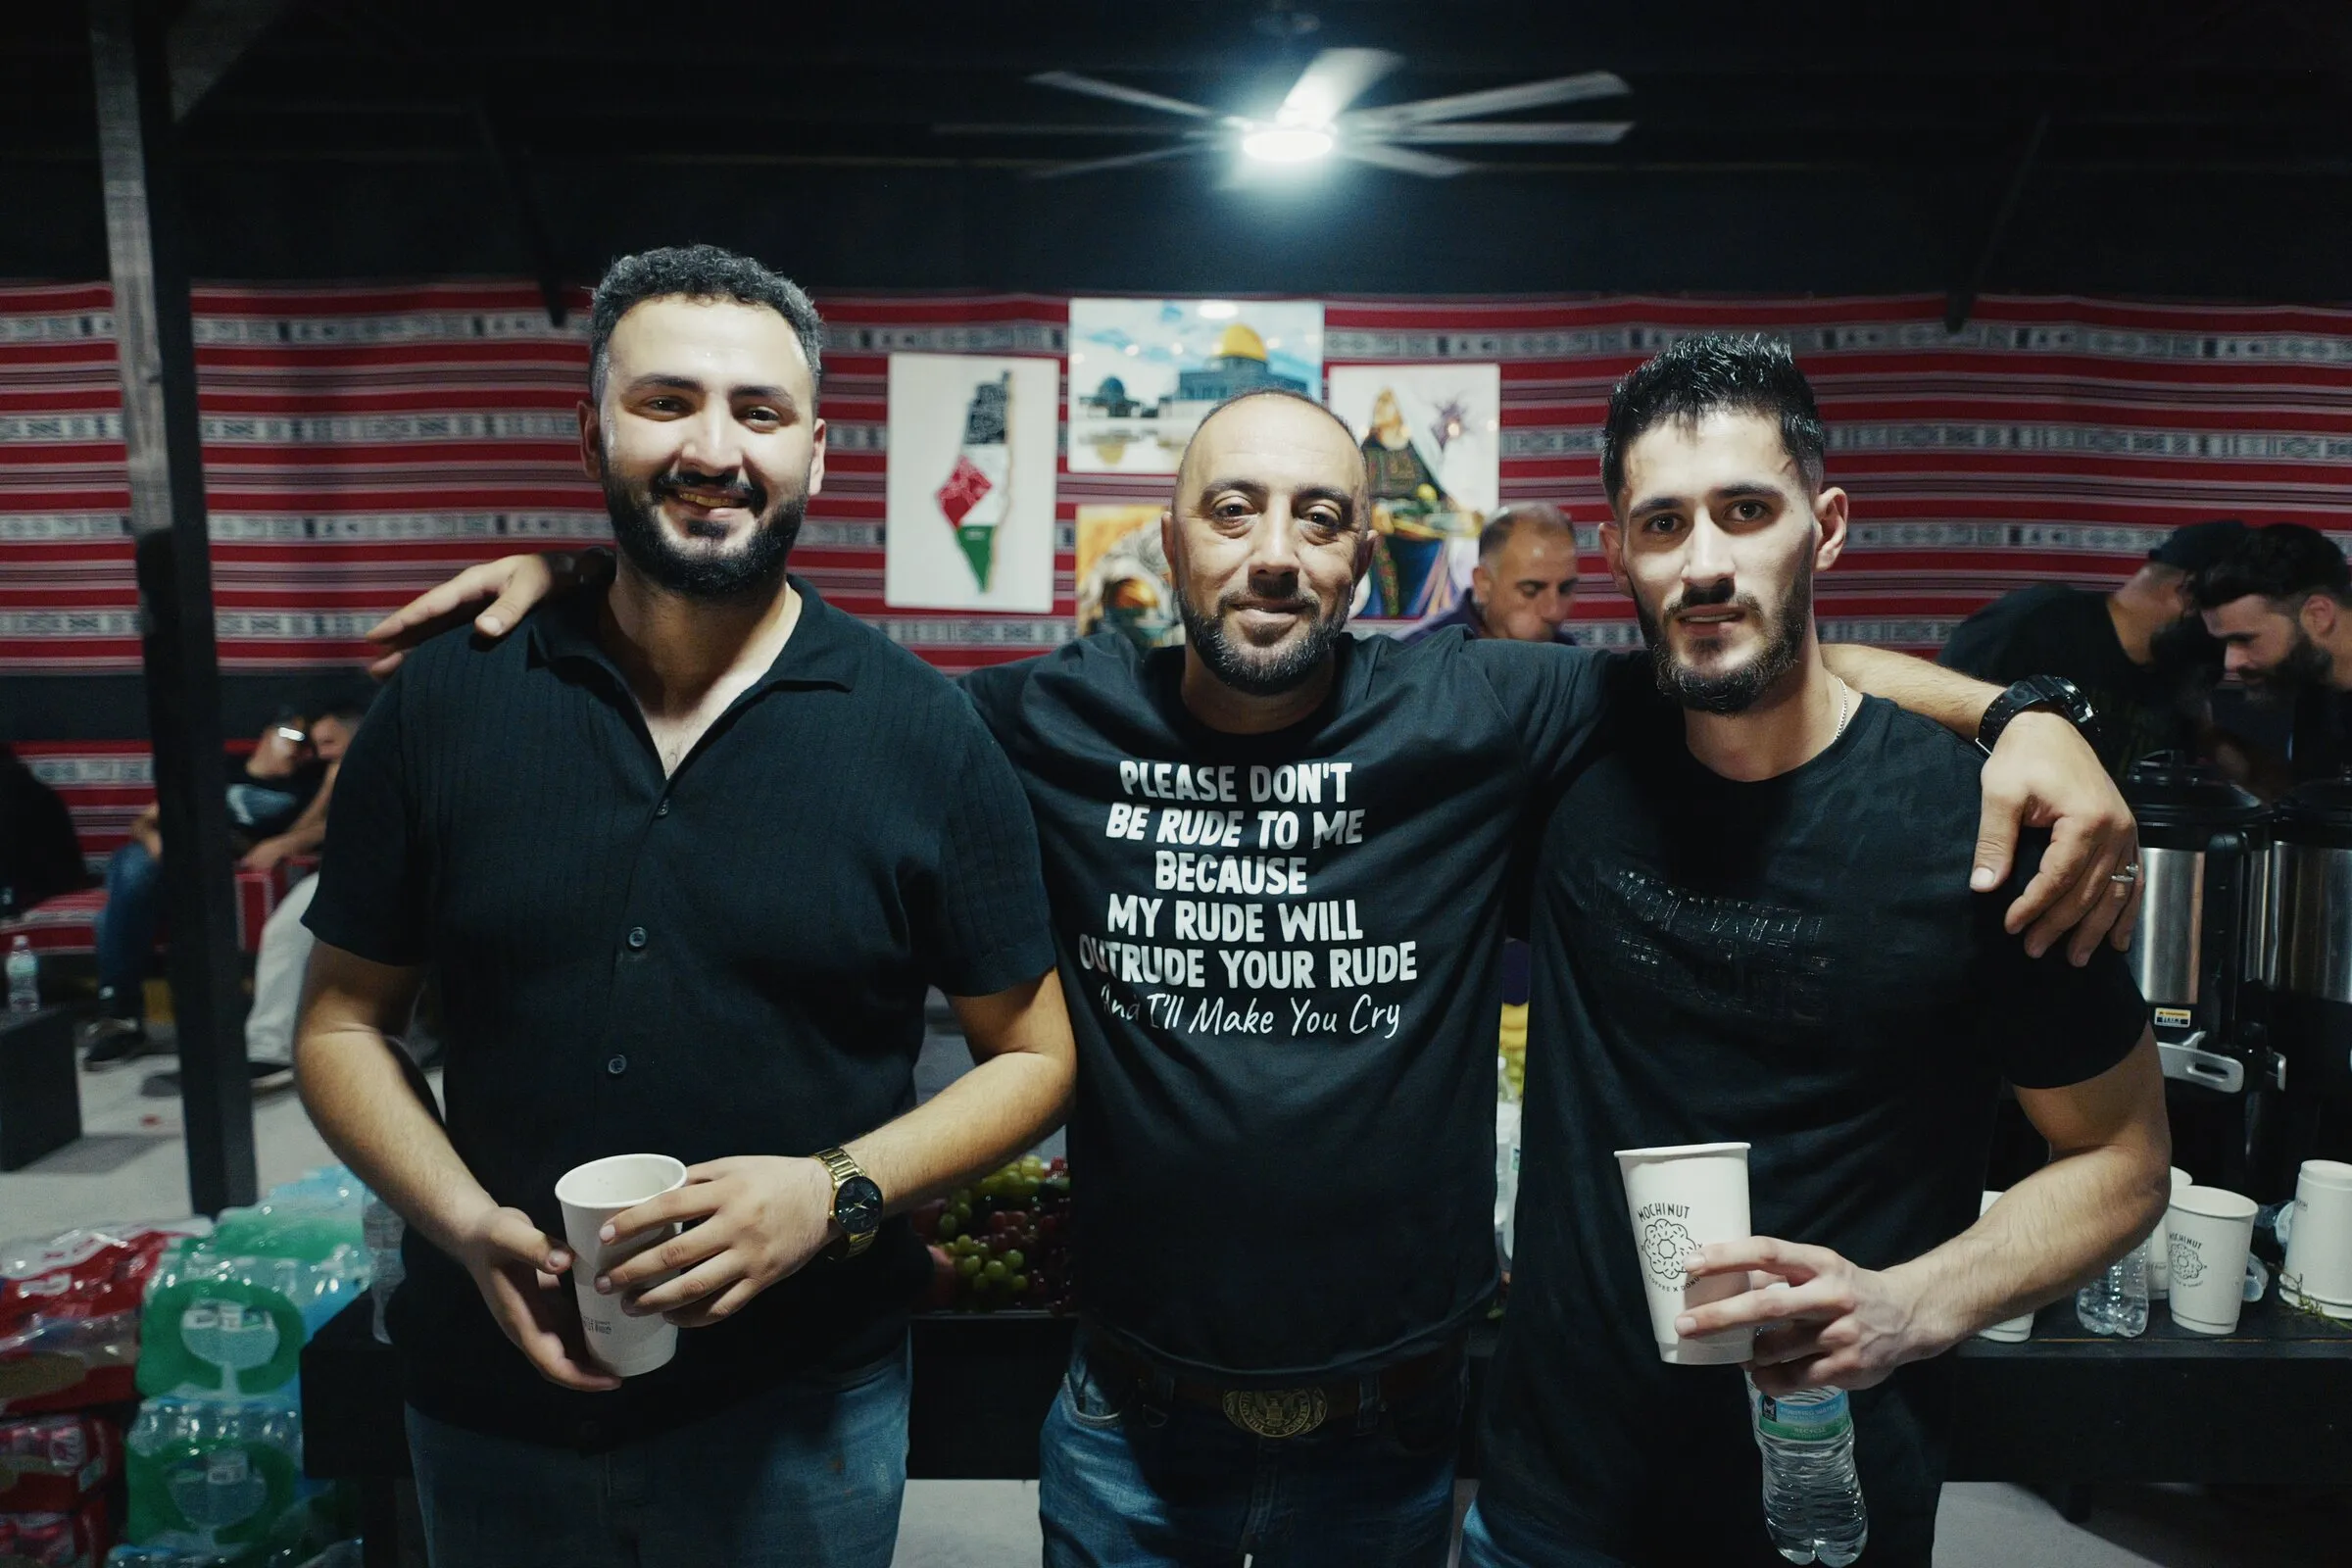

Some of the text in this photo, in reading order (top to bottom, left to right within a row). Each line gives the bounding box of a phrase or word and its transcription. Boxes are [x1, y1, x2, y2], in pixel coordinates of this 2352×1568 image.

[1119, 760, 1352, 804] PLEASE DON'T
[1105, 802, 1366, 850] BE RUDE TO ME
[1154, 850, 1307, 896] BECAUSE
[1107, 893, 1363, 943] MY RUDE WILL
[1078, 933, 1418, 990] OUTRUDE YOUR RUDE
[1100, 982, 1400, 1039] And I'll Make You Cry
[1637, 1202, 1690, 1223] MOCHINUT
[1681, 1276, 1701, 1291] DONU
